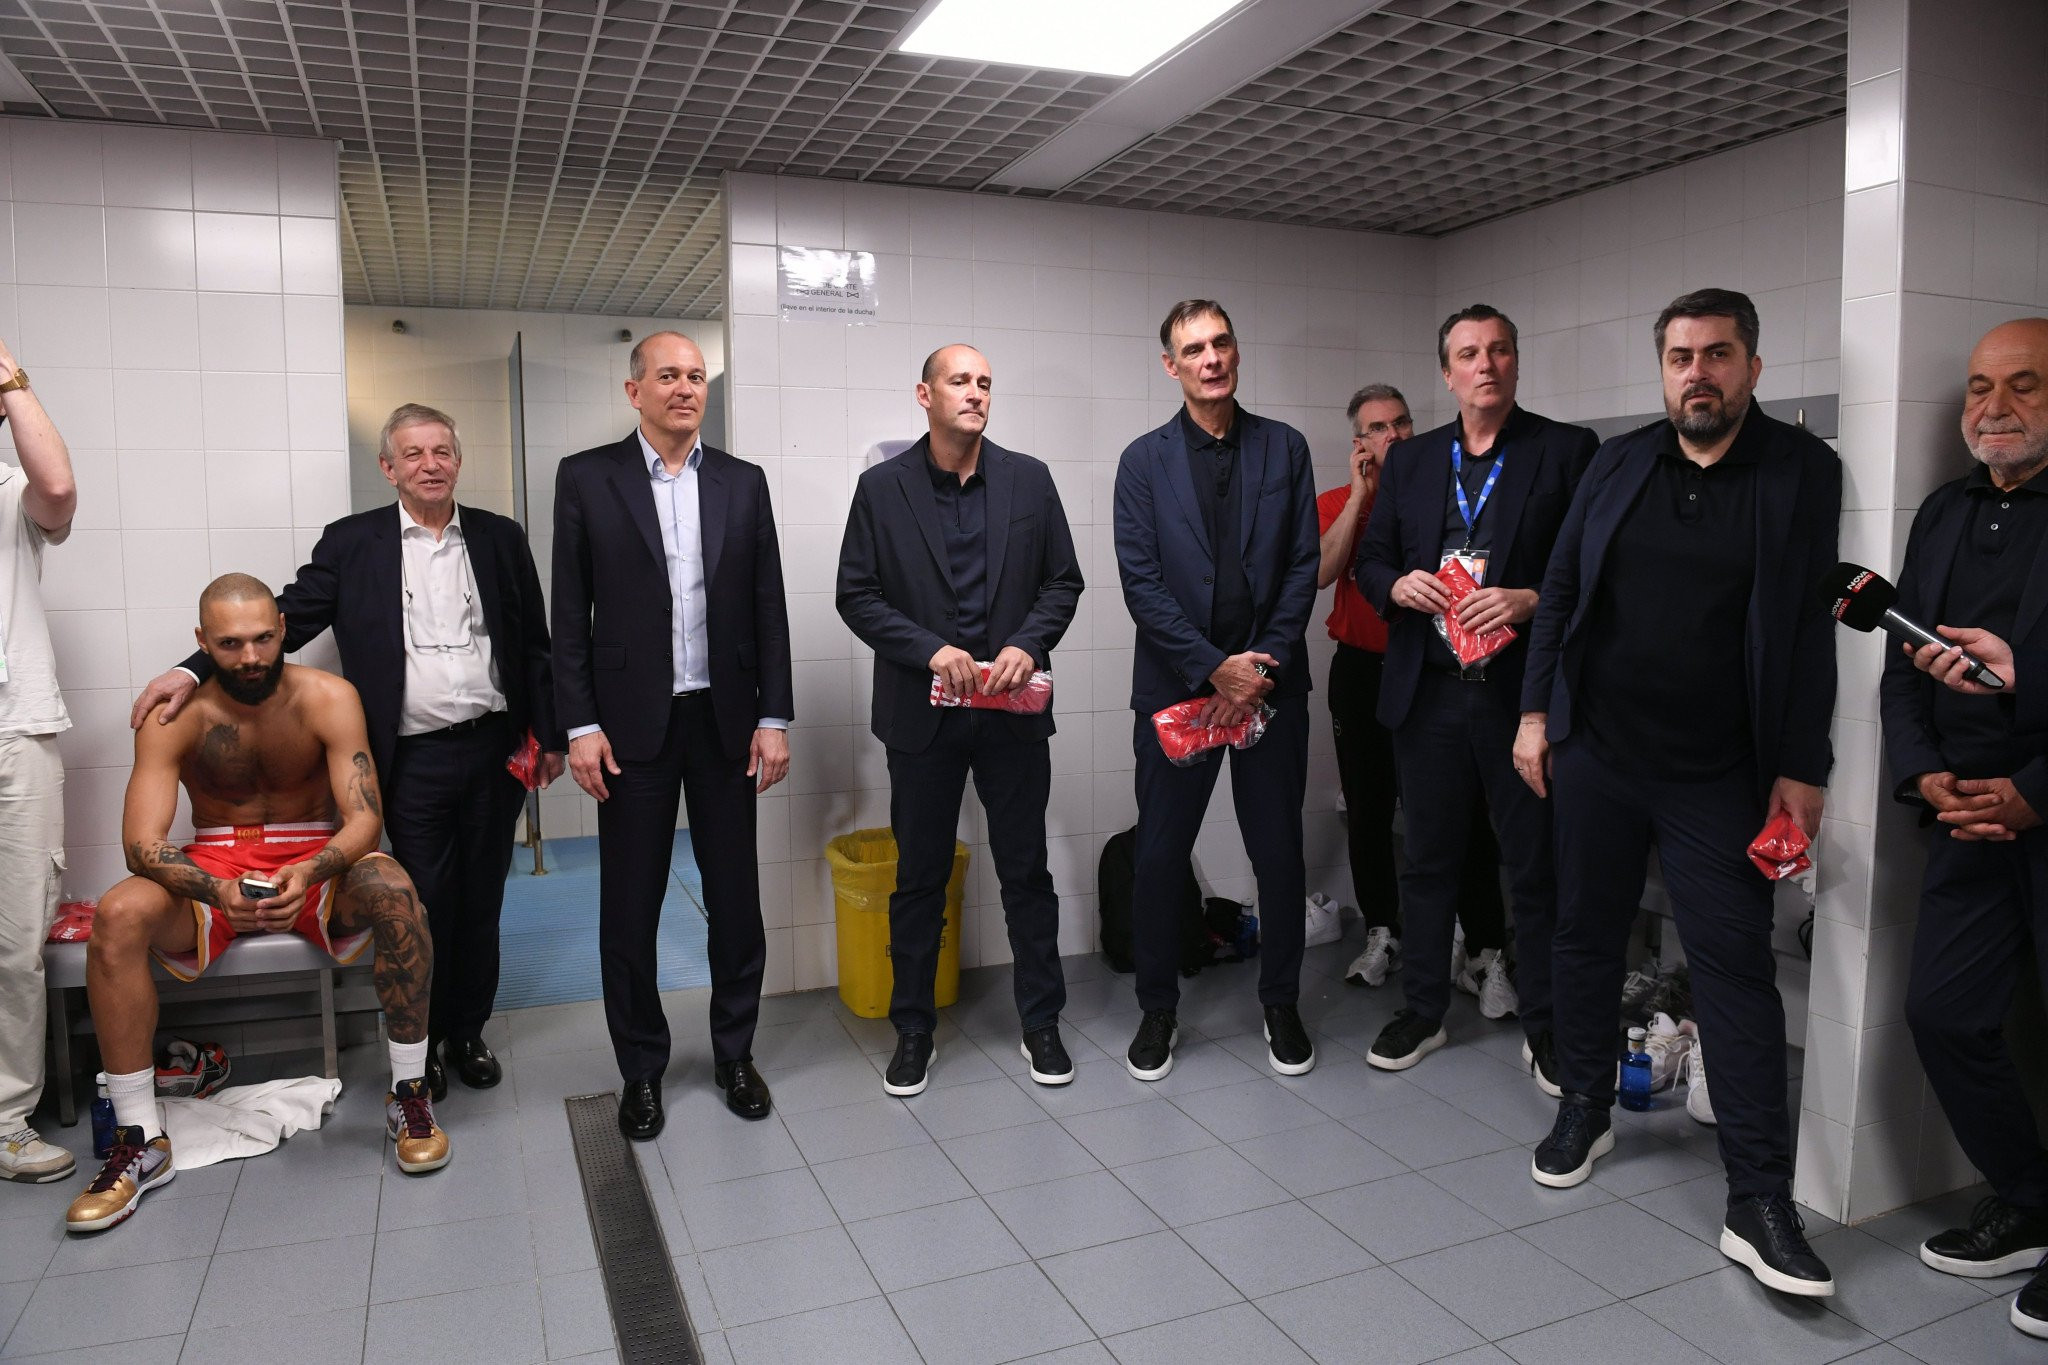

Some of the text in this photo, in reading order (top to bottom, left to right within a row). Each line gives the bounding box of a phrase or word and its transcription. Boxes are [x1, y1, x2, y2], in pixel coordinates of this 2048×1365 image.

[811, 289, 844, 298] GENERAL
[854, 307, 876, 316] ducha)
[1846, 571, 1869, 590] NOVA
[1854, 574, 1873, 590] SPORTS
